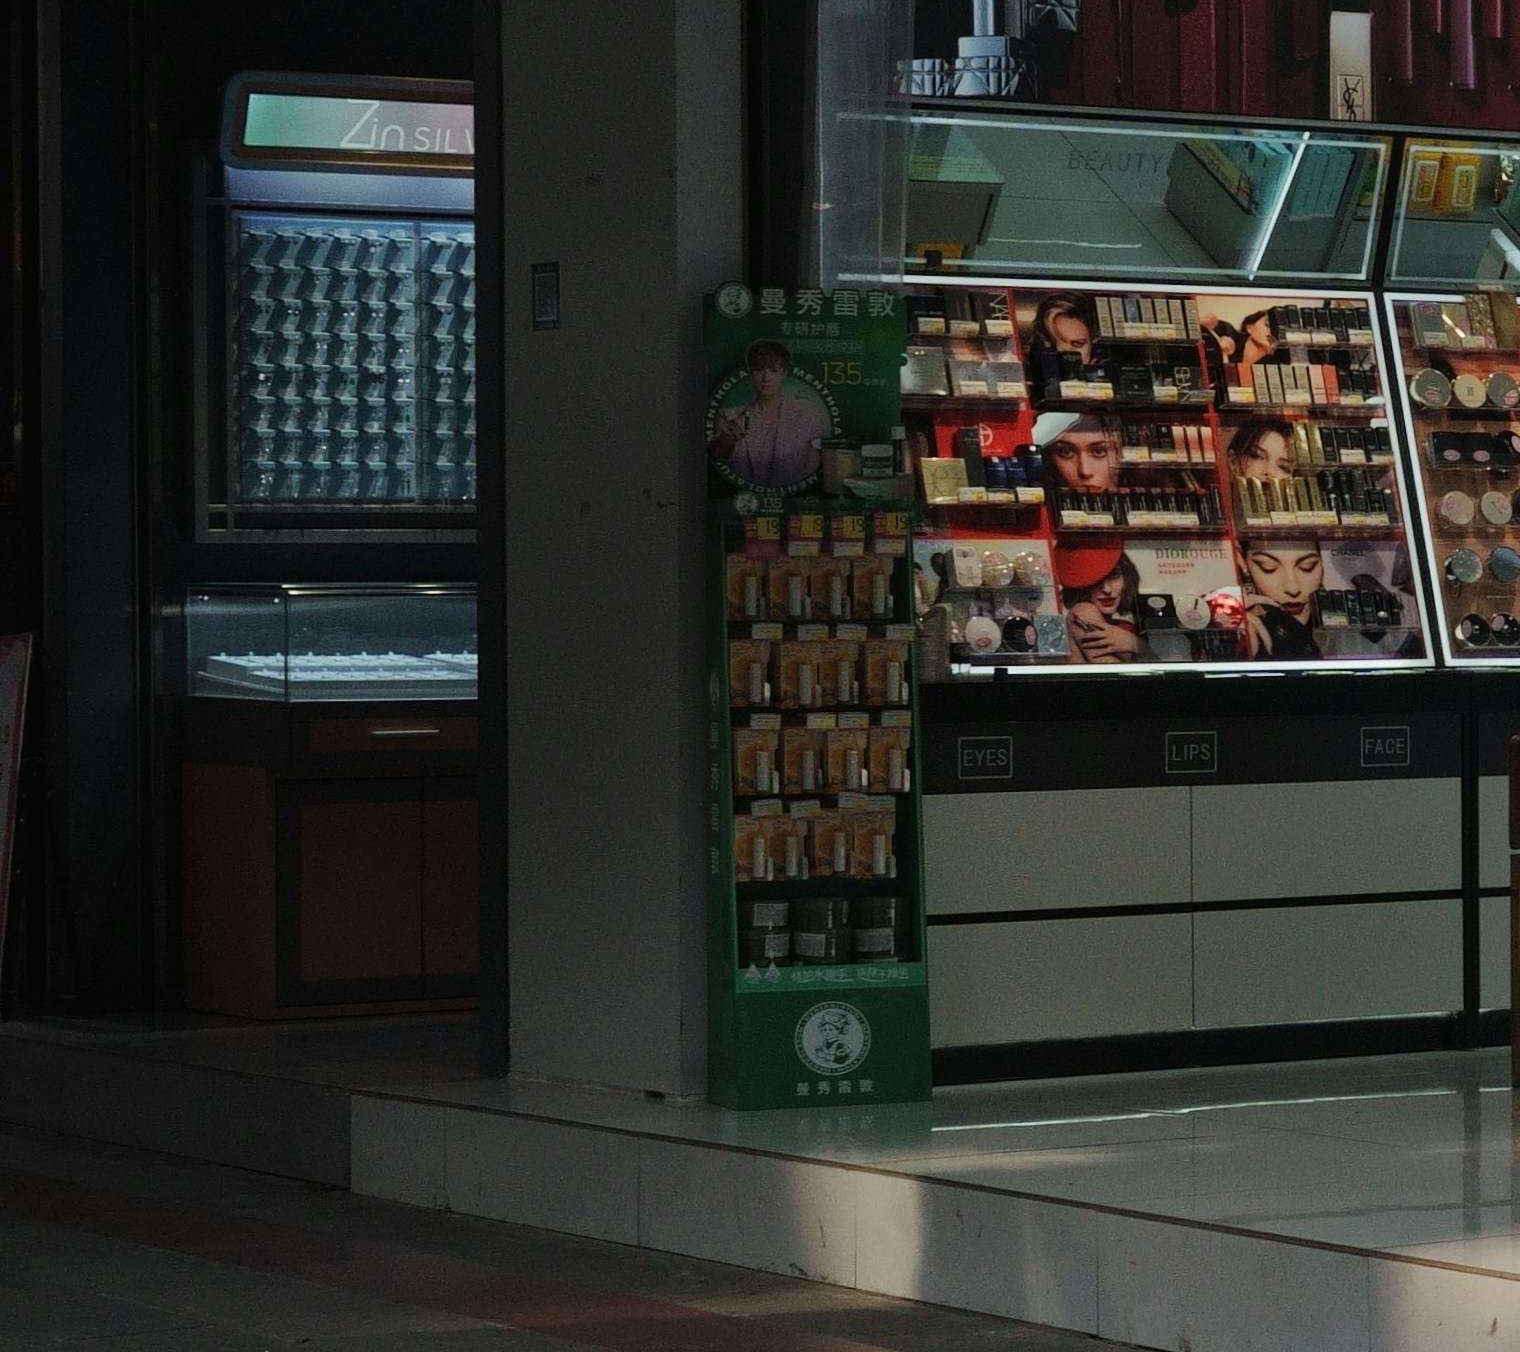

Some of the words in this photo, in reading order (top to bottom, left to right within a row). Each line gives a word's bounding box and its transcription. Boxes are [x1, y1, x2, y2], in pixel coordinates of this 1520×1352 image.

[339, 98, 407, 150] Zin
[1067, 149, 1165, 174] BEAUTY
[759, 287, 896, 318] 曼秀雷敦
[780, 321, 842, 338] 专研护唇
[821, 360, 863, 386] 135
[1171, 743, 1211, 763] LIPS
[1364, 736, 1407, 757] FACE
[962, 748, 1009, 768] EYES
[795, 1078, 875, 1097] 曼秀雷敦
